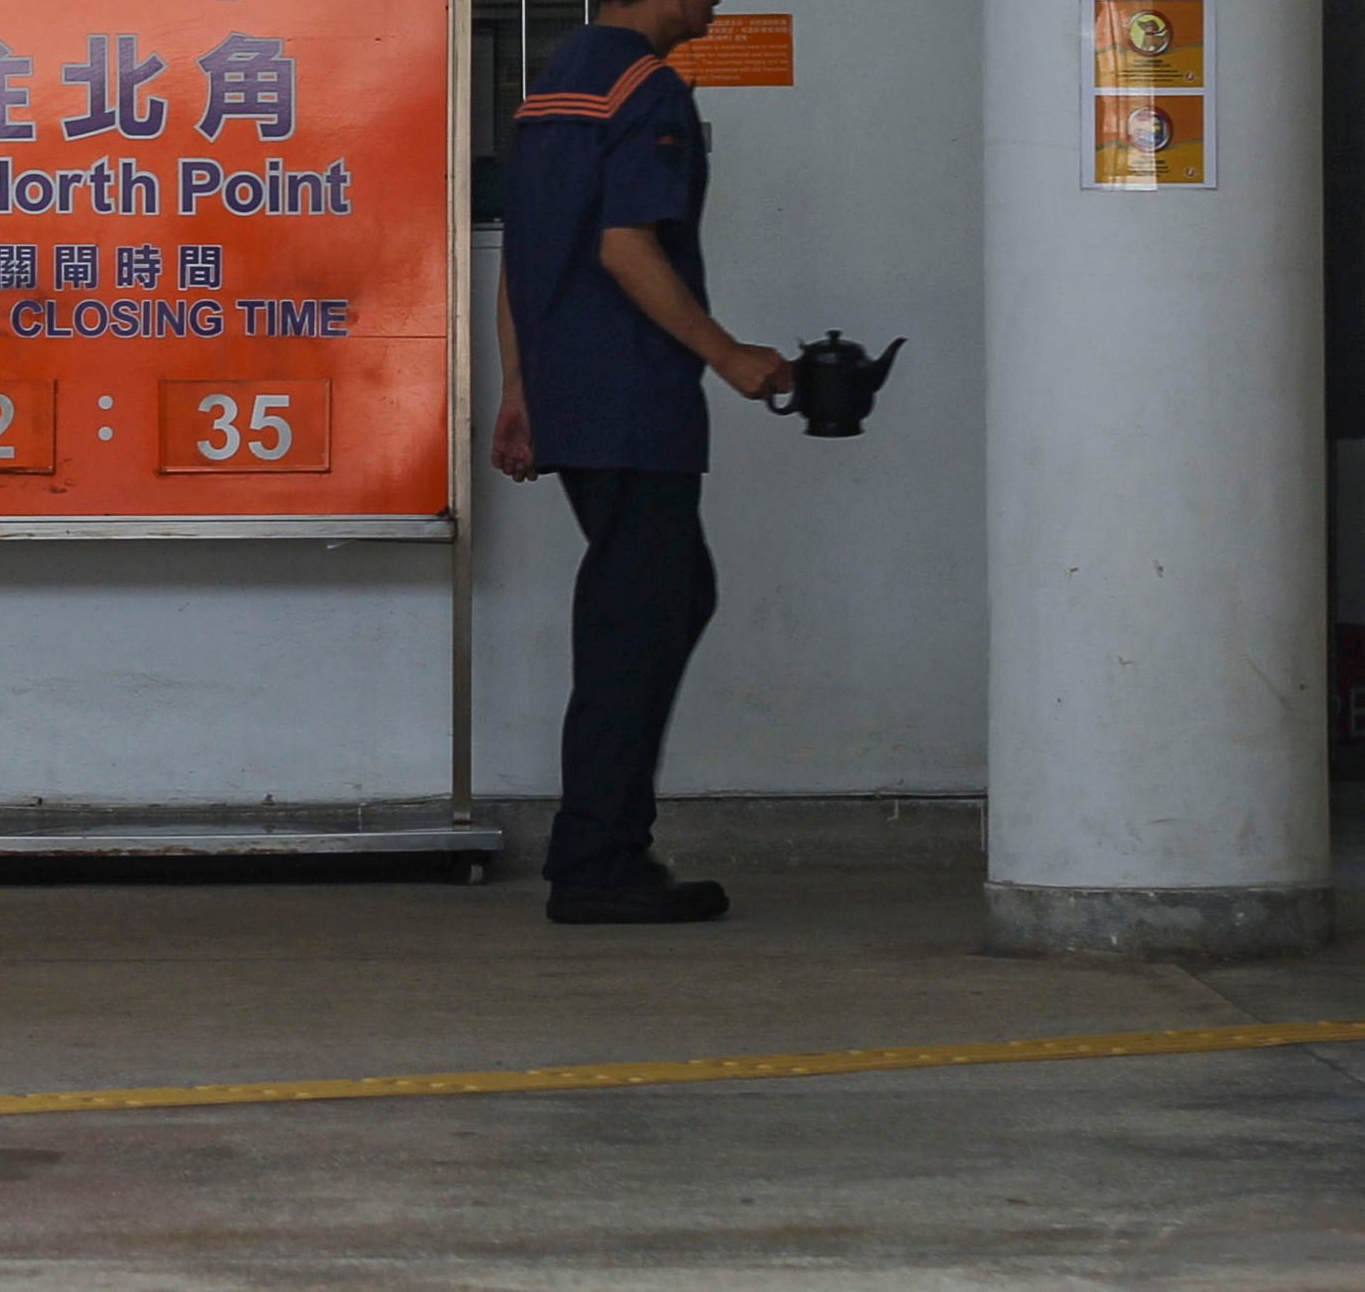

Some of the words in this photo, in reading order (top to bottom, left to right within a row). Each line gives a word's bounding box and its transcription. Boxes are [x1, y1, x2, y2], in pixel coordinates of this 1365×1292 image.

[178, 155, 353, 216] Point
[10, 299, 225, 340] CLOSING
[236, 298, 350, 339] TIME
[197, 394, 294, 461] 35
